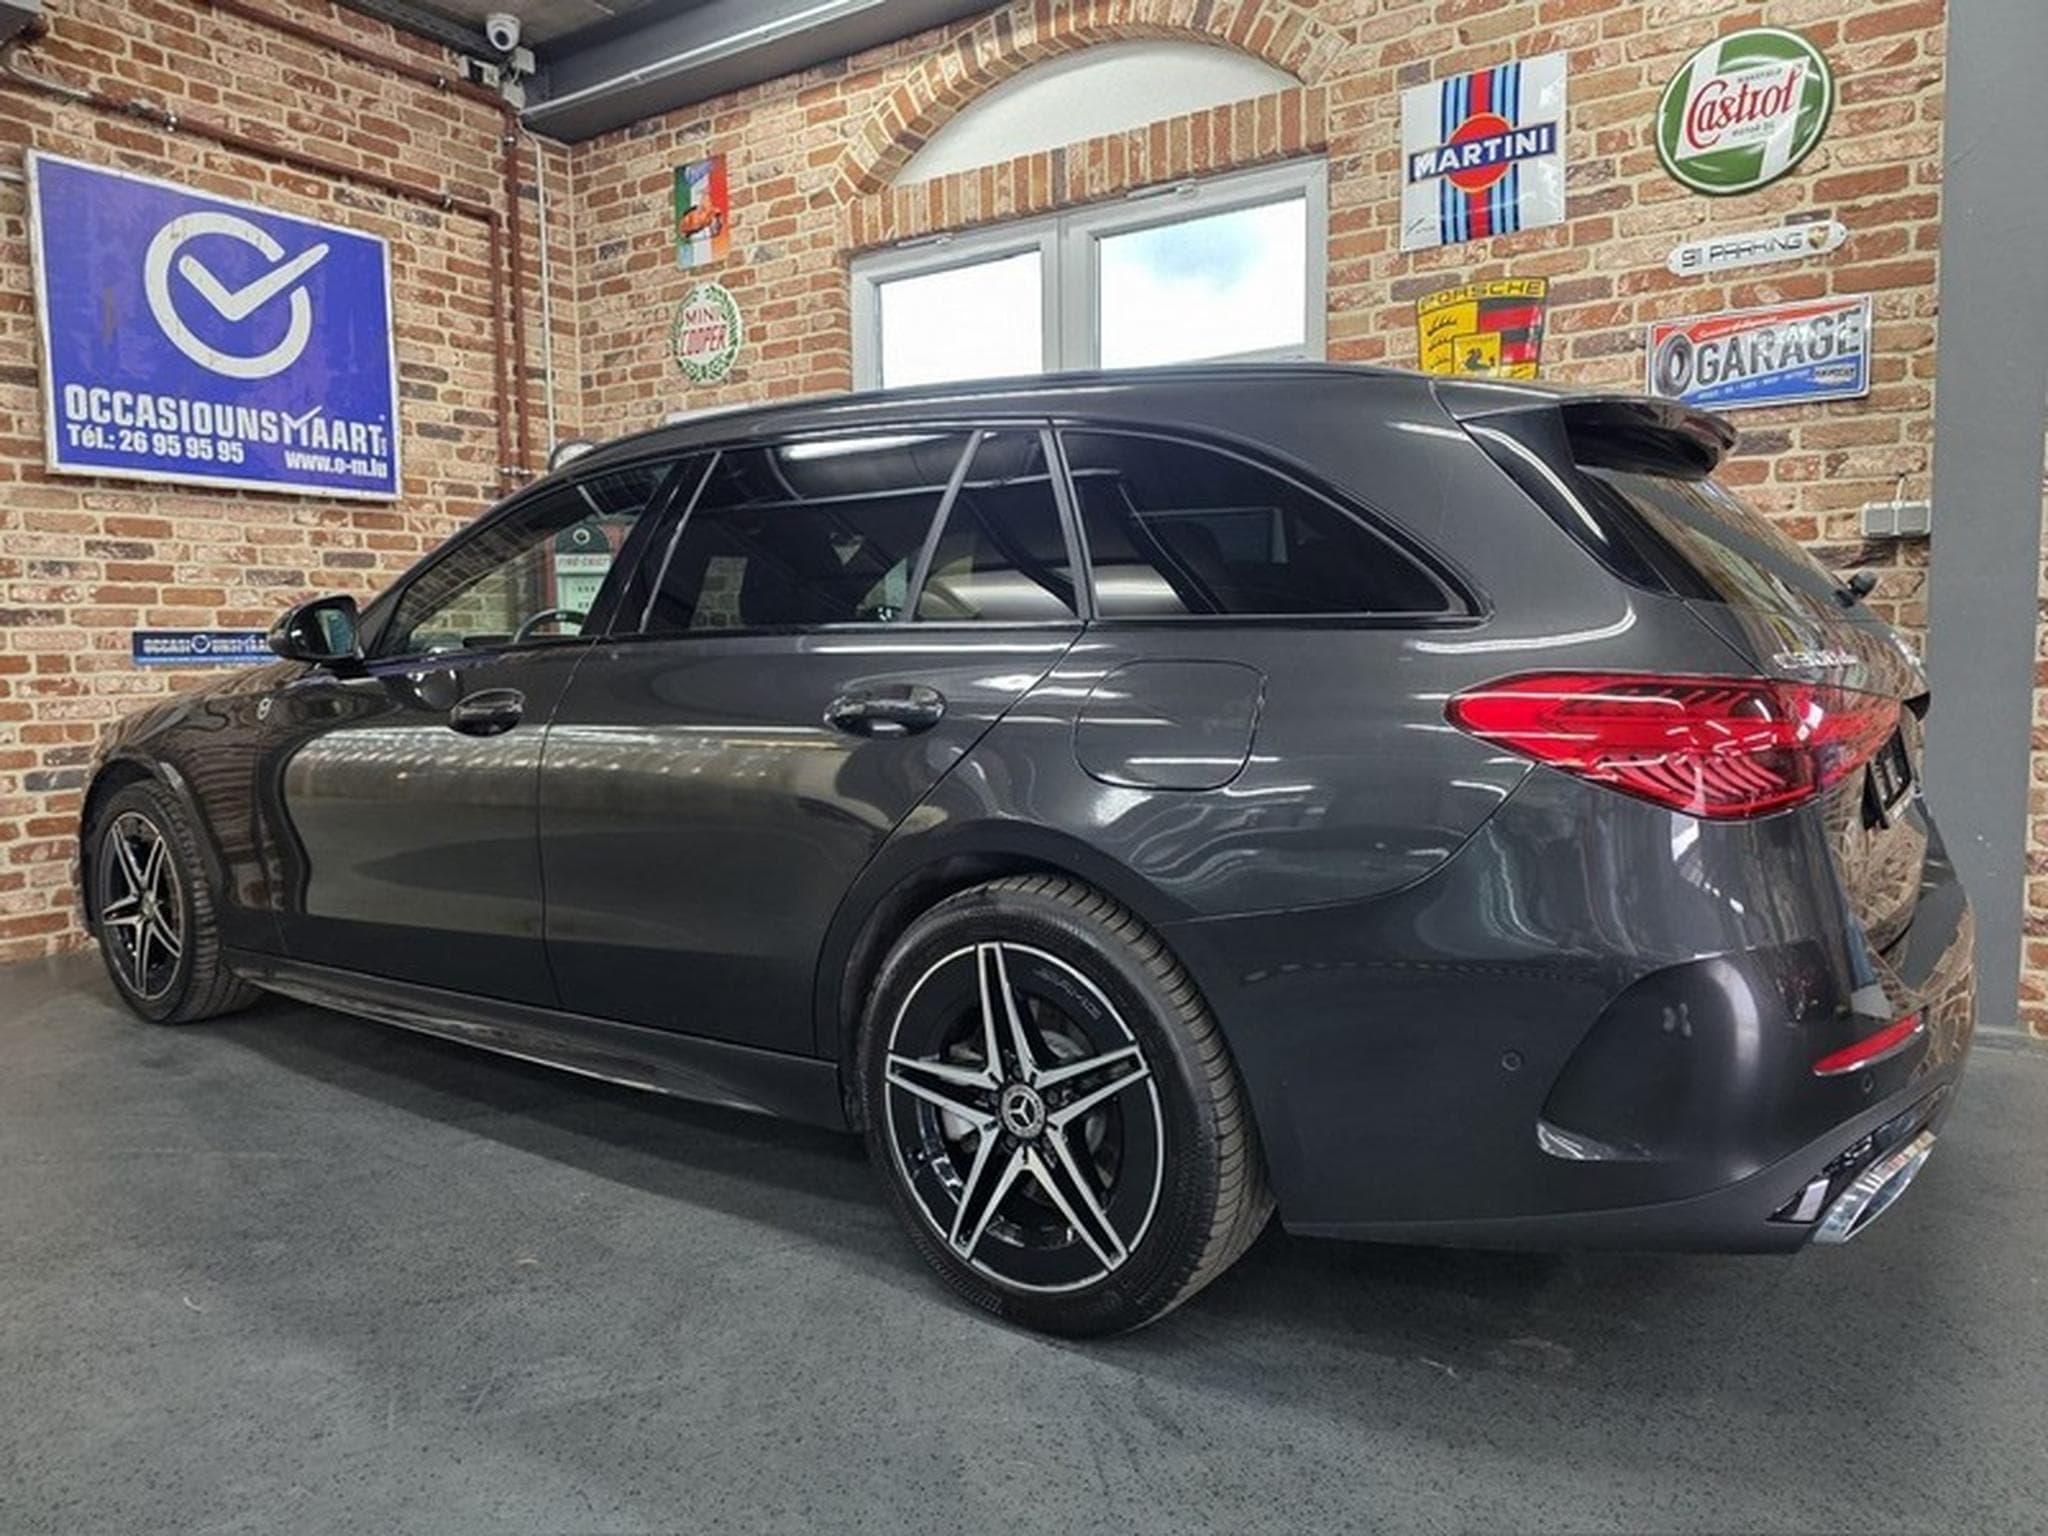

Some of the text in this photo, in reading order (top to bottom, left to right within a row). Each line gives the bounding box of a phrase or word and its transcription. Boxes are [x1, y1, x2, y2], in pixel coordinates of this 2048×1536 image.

[1687, 64, 1799, 149] Castrol
[1413, 127, 1549, 178] MARTINI
[1709, 232, 1804, 261] PARKING
[1421, 280, 1542, 311] PORSCHE
[1697, 306, 1861, 386] GARAGE
[119, 429, 148, 453] 26
[152, 432, 181, 457] 95
[185, 436, 213, 460] 95
[217, 440, 244, 464] 95
[284, 450, 388, 479] www.o-m.lu
